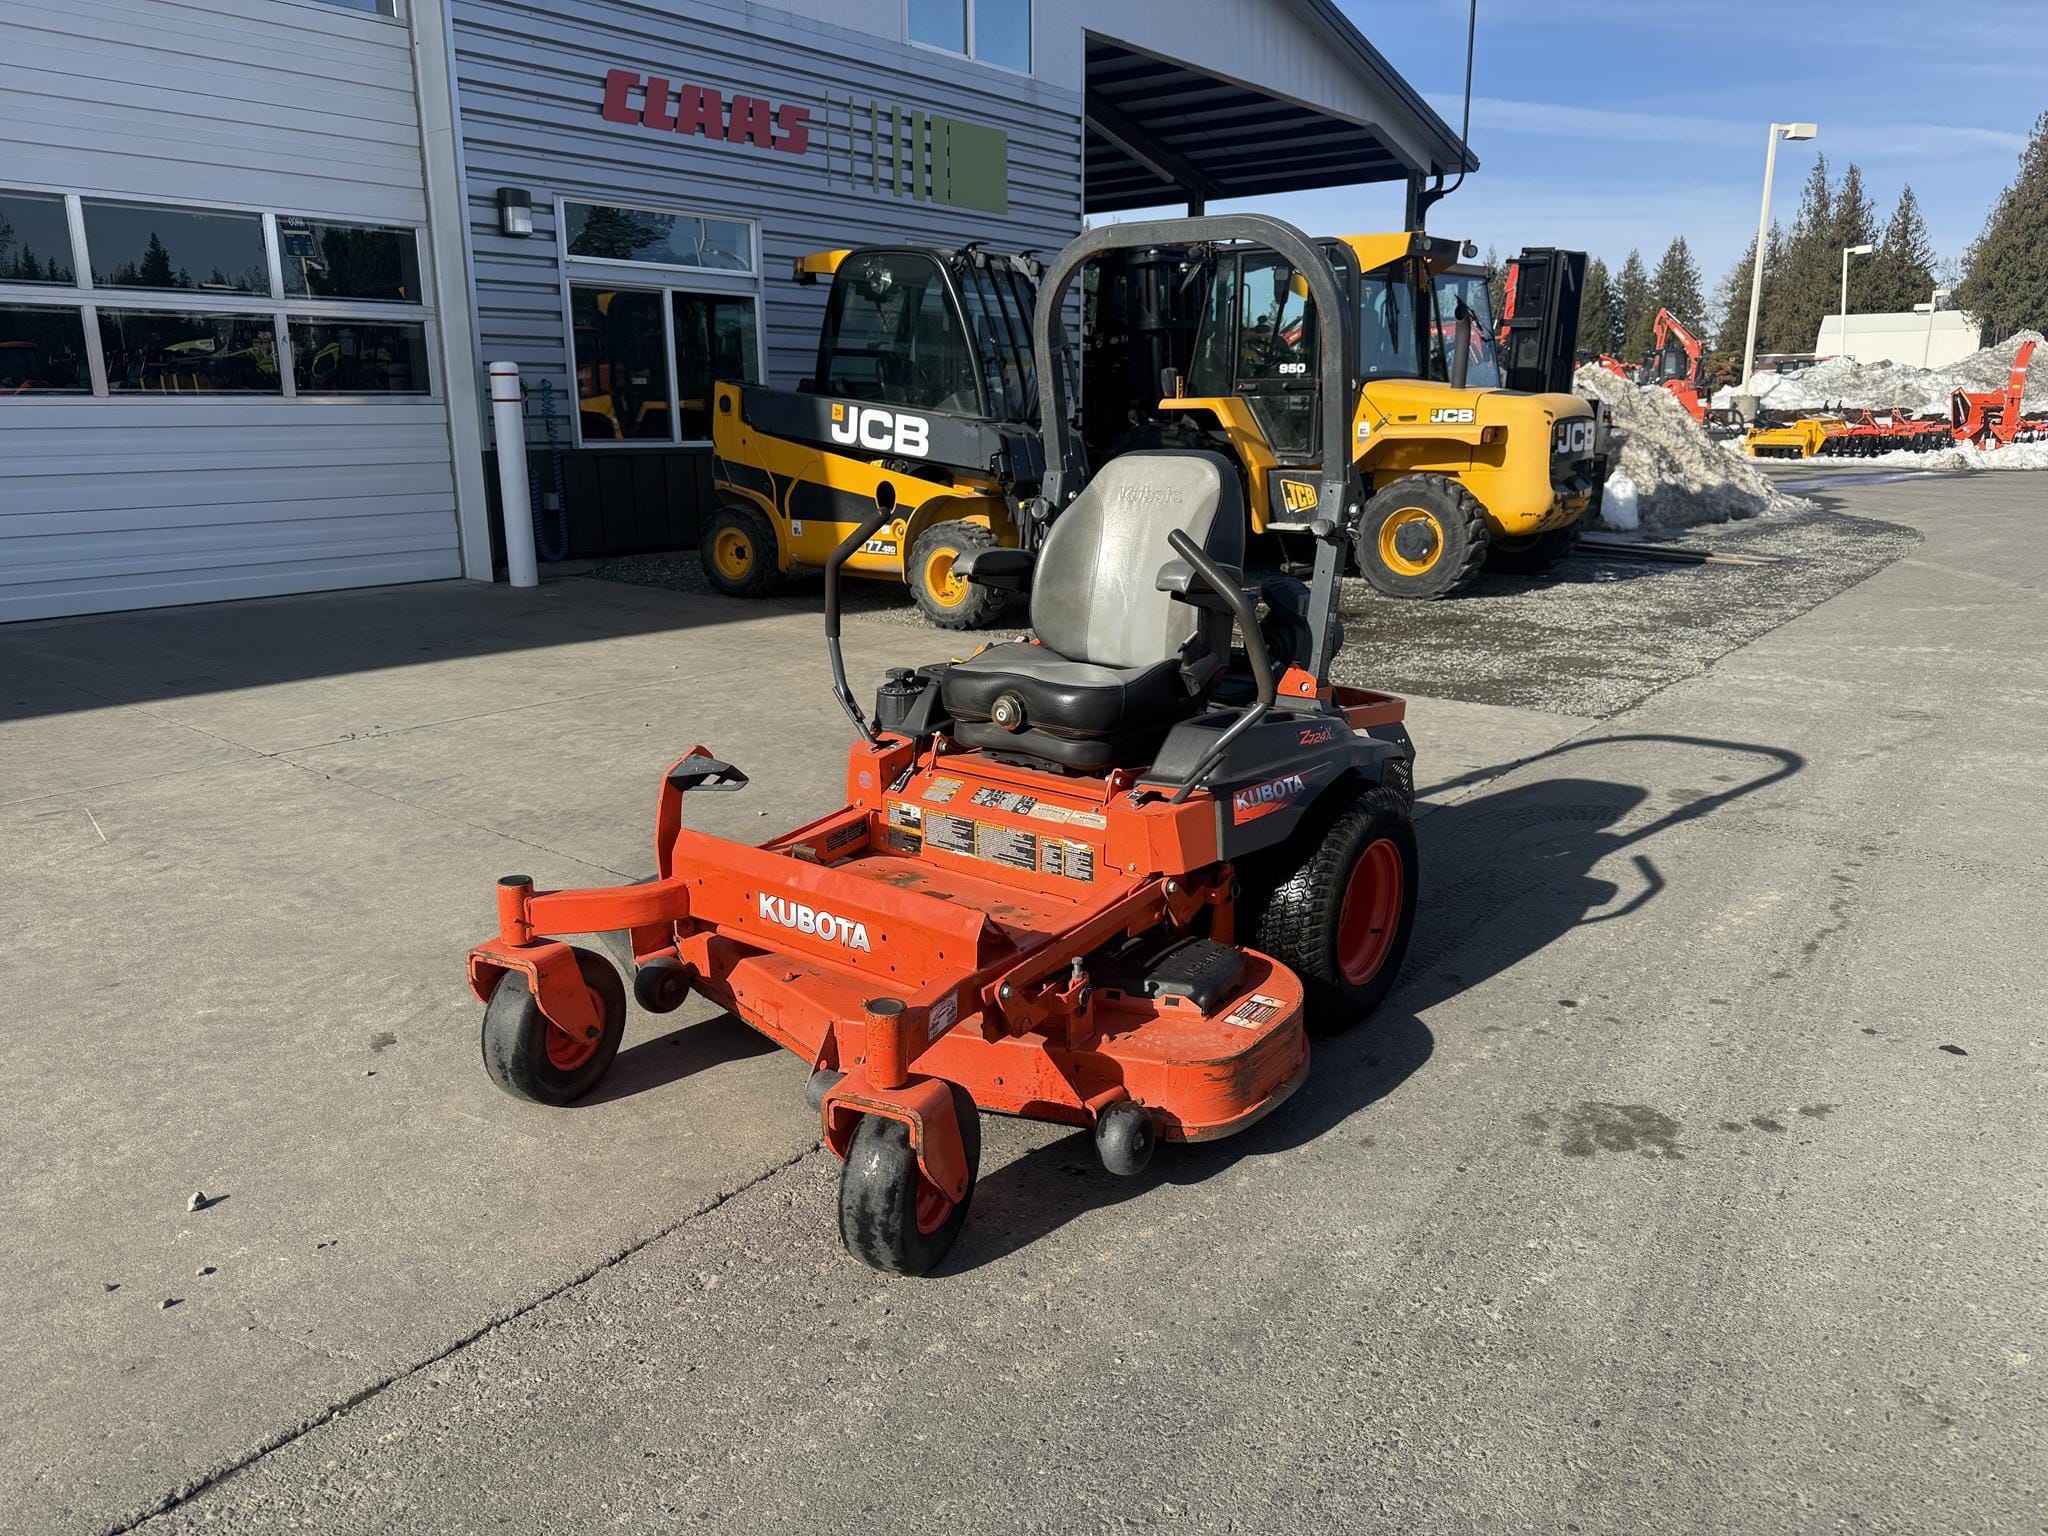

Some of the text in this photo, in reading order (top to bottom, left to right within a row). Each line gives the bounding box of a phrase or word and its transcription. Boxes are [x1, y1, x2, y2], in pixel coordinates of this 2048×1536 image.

[602, 69, 811, 155] CLAAS
[1279, 364, 1306, 374] 950
[831, 404, 929, 457] JCB
[1430, 408, 1474, 423] JCB
[1557, 422, 1595, 454] JCB
[1286, 483, 1315, 511] JCB
[1235, 774, 1306, 812] KUBOTA
[758, 891, 871, 953] KUBOTA
